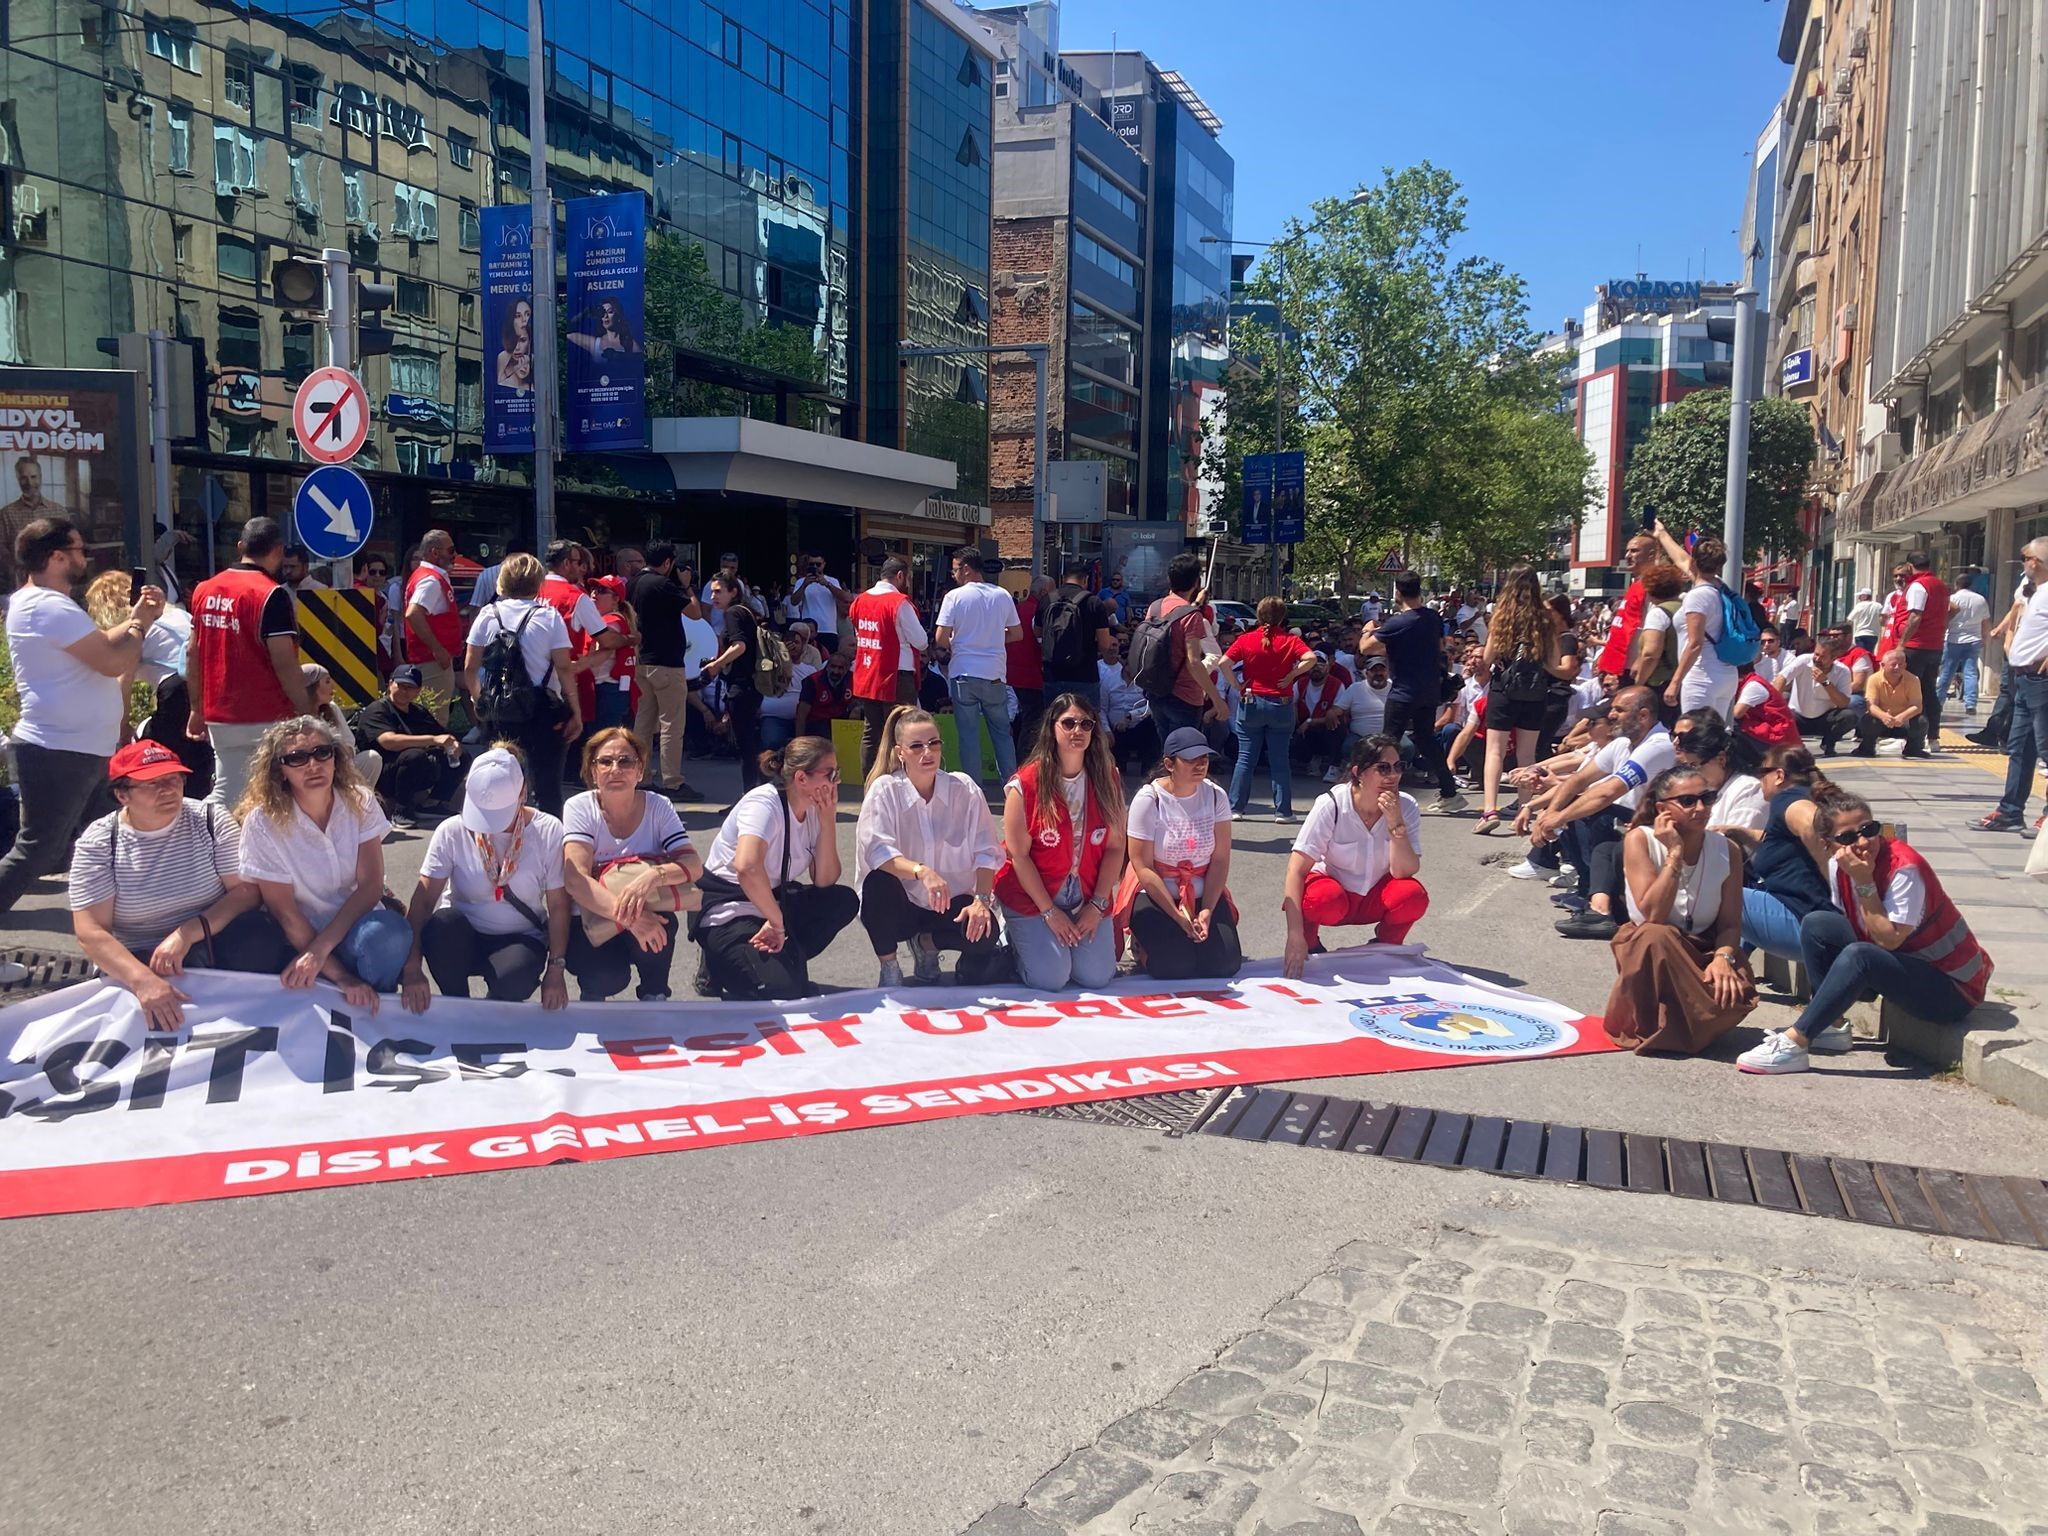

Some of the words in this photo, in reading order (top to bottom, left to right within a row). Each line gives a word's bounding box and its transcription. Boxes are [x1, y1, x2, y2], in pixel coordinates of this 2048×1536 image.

[596, 247, 626, 257] HAZİRAN
[585, 255, 626, 267] CUMARTESİ
[514, 269, 529, 278] GALA
[573, 268, 600, 278] YEMEKLİ
[600, 267, 617, 276] GALA
[616, 266, 638, 275] GECESİ
[490, 284, 520, 295] MERVE
[586, 279, 625, 292] ASLIZEN
[1608, 279, 1701, 300] KORDON
[206, 594, 236, 612] DİSK
[858, 617, 879, 632] DİSK
[863, 652, 872, 669] İŞ
[603, 1014, 864, 1071] EŞİT
[900, 990, 1252, 1036] ÜCRET
[223, 1141, 449, 1185] DİSK
[468, 1102, 849, 1159] GENEL-İŞ
[860, 1060, 1240, 1115] SENDİKASI
